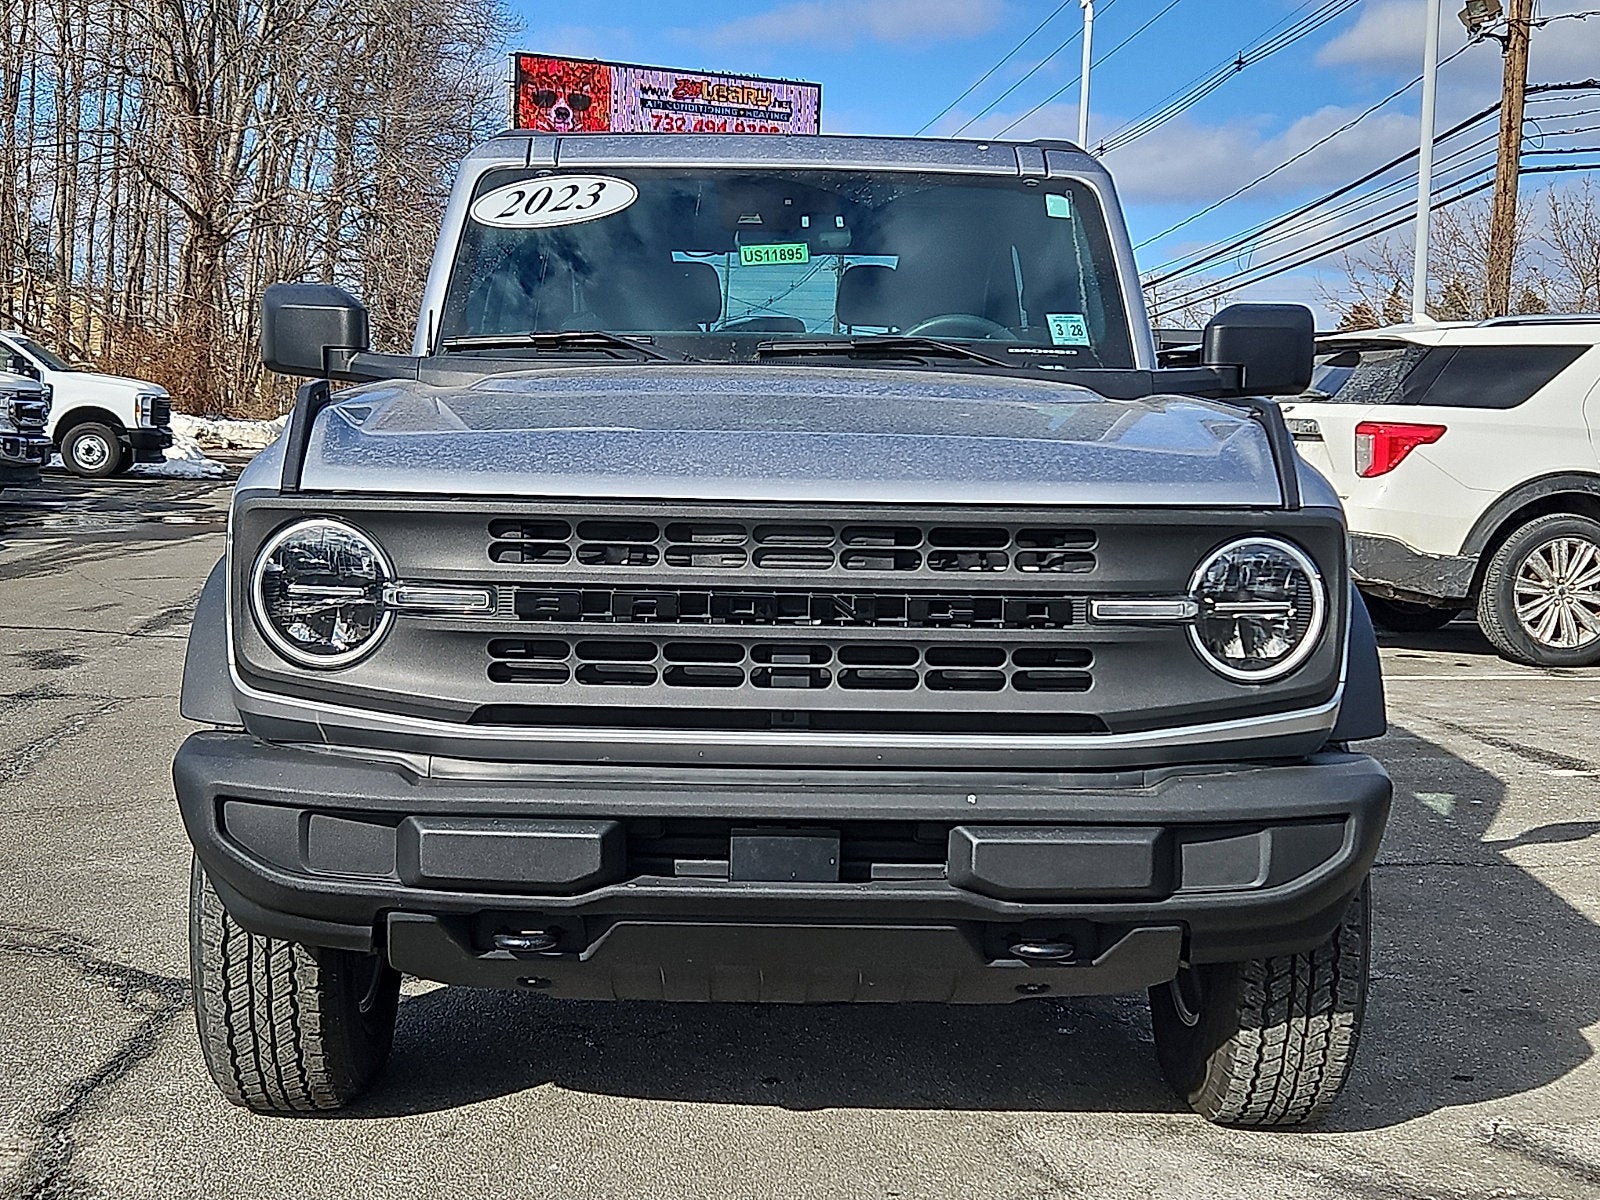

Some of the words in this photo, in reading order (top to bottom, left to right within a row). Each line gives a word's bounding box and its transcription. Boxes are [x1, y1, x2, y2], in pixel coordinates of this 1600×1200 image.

[666, 101, 739, 116] CONDITIONING
[745, 111, 789, 121] HEATING
[494, 181, 607, 219] 2023
[743, 247, 803, 263] US11895
[1055, 323, 1064, 336] 3
[1069, 324, 1084, 337] 28
